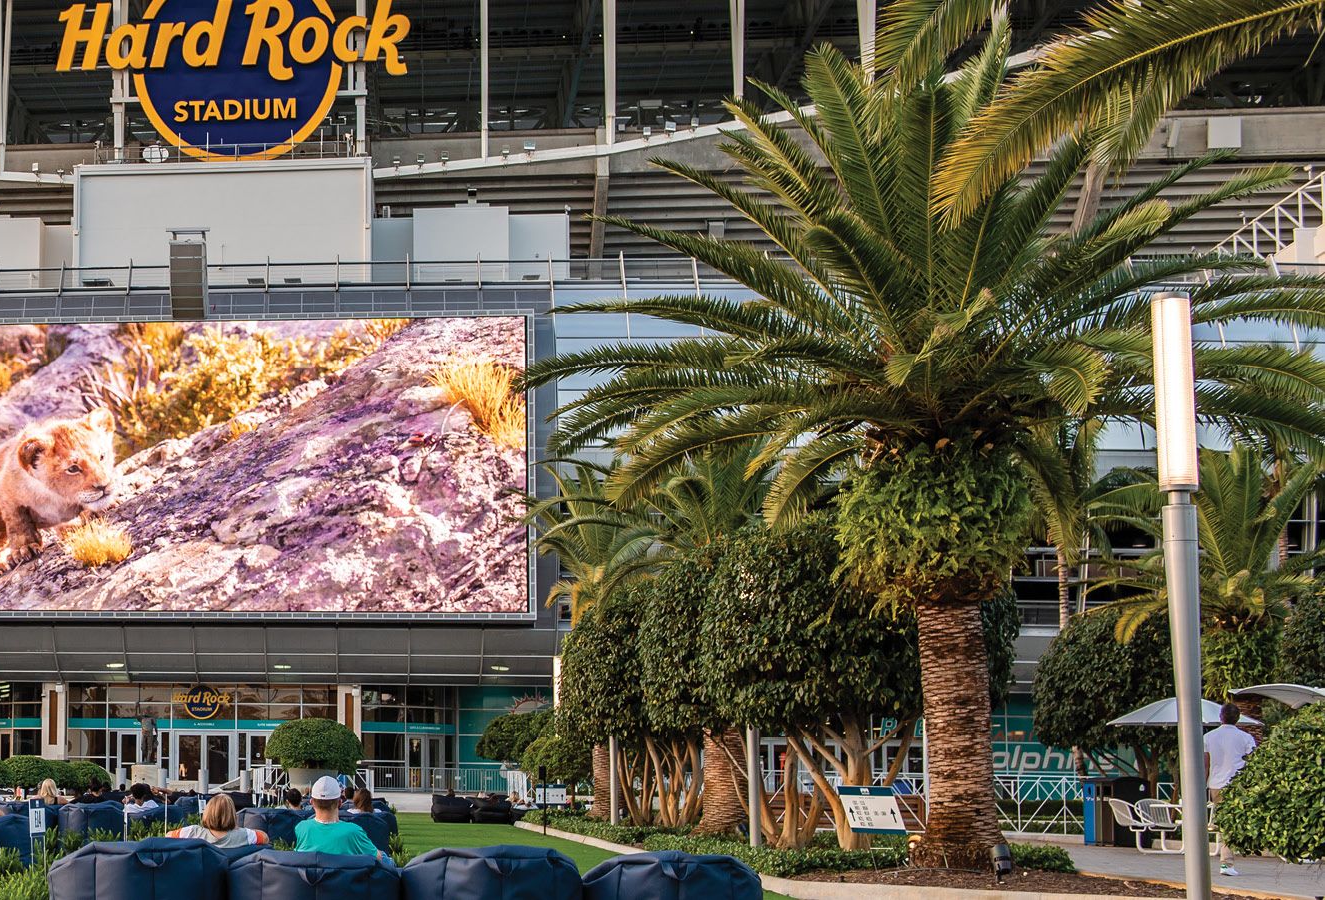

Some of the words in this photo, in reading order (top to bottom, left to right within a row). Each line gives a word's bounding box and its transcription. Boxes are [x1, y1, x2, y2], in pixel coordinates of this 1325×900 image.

[55, 0, 232, 72] Hard
[241, 0, 411, 80] Rock
[173, 97, 298, 123] STADIUM
[172, 691, 202, 704] Hard
[203, 691, 231, 706] Rock
